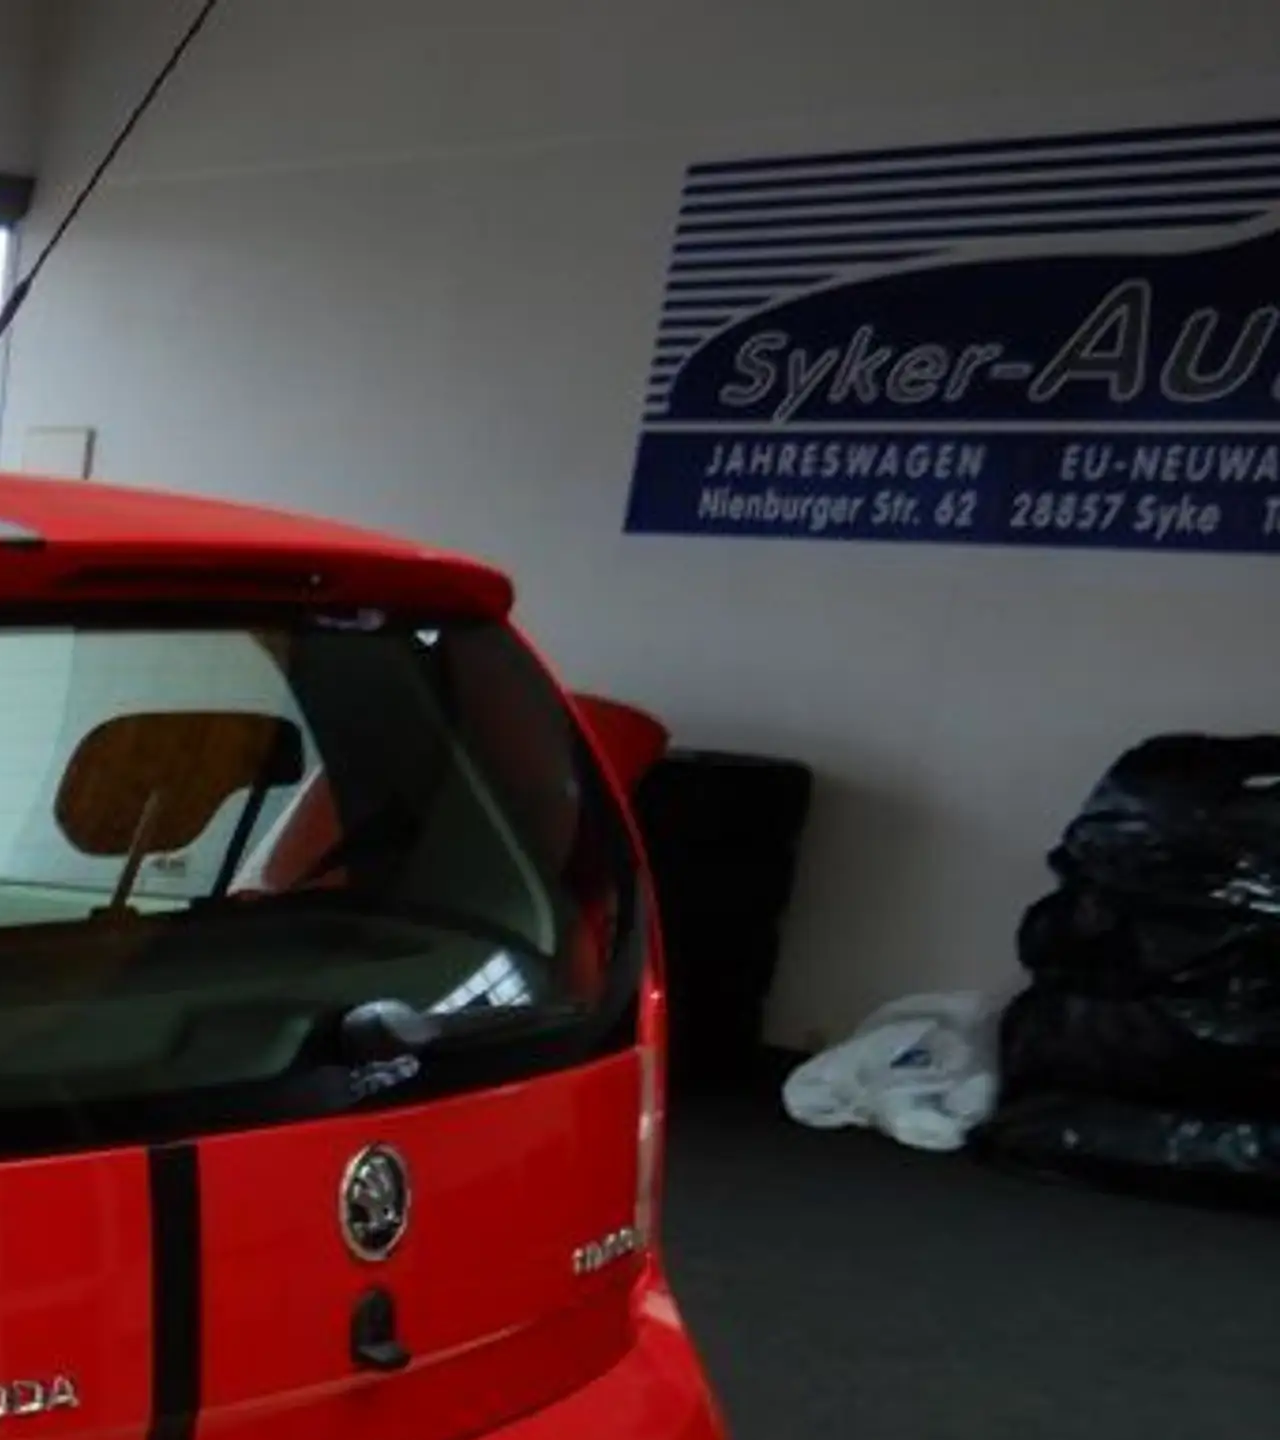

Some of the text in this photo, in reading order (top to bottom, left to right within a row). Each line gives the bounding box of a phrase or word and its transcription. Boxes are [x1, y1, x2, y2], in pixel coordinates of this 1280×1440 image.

[719, 277, 1280, 426] Syker-Au
[704, 442, 1280, 482] JAHRESWAGEN EU-NEUWA
[697, 486, 865, 532] Nienburger
[870, 490, 920, 527] Str.
[933, 490, 977, 528] 62
[1009, 492, 1126, 531] 28857
[1133, 493, 1222, 542] Syke
